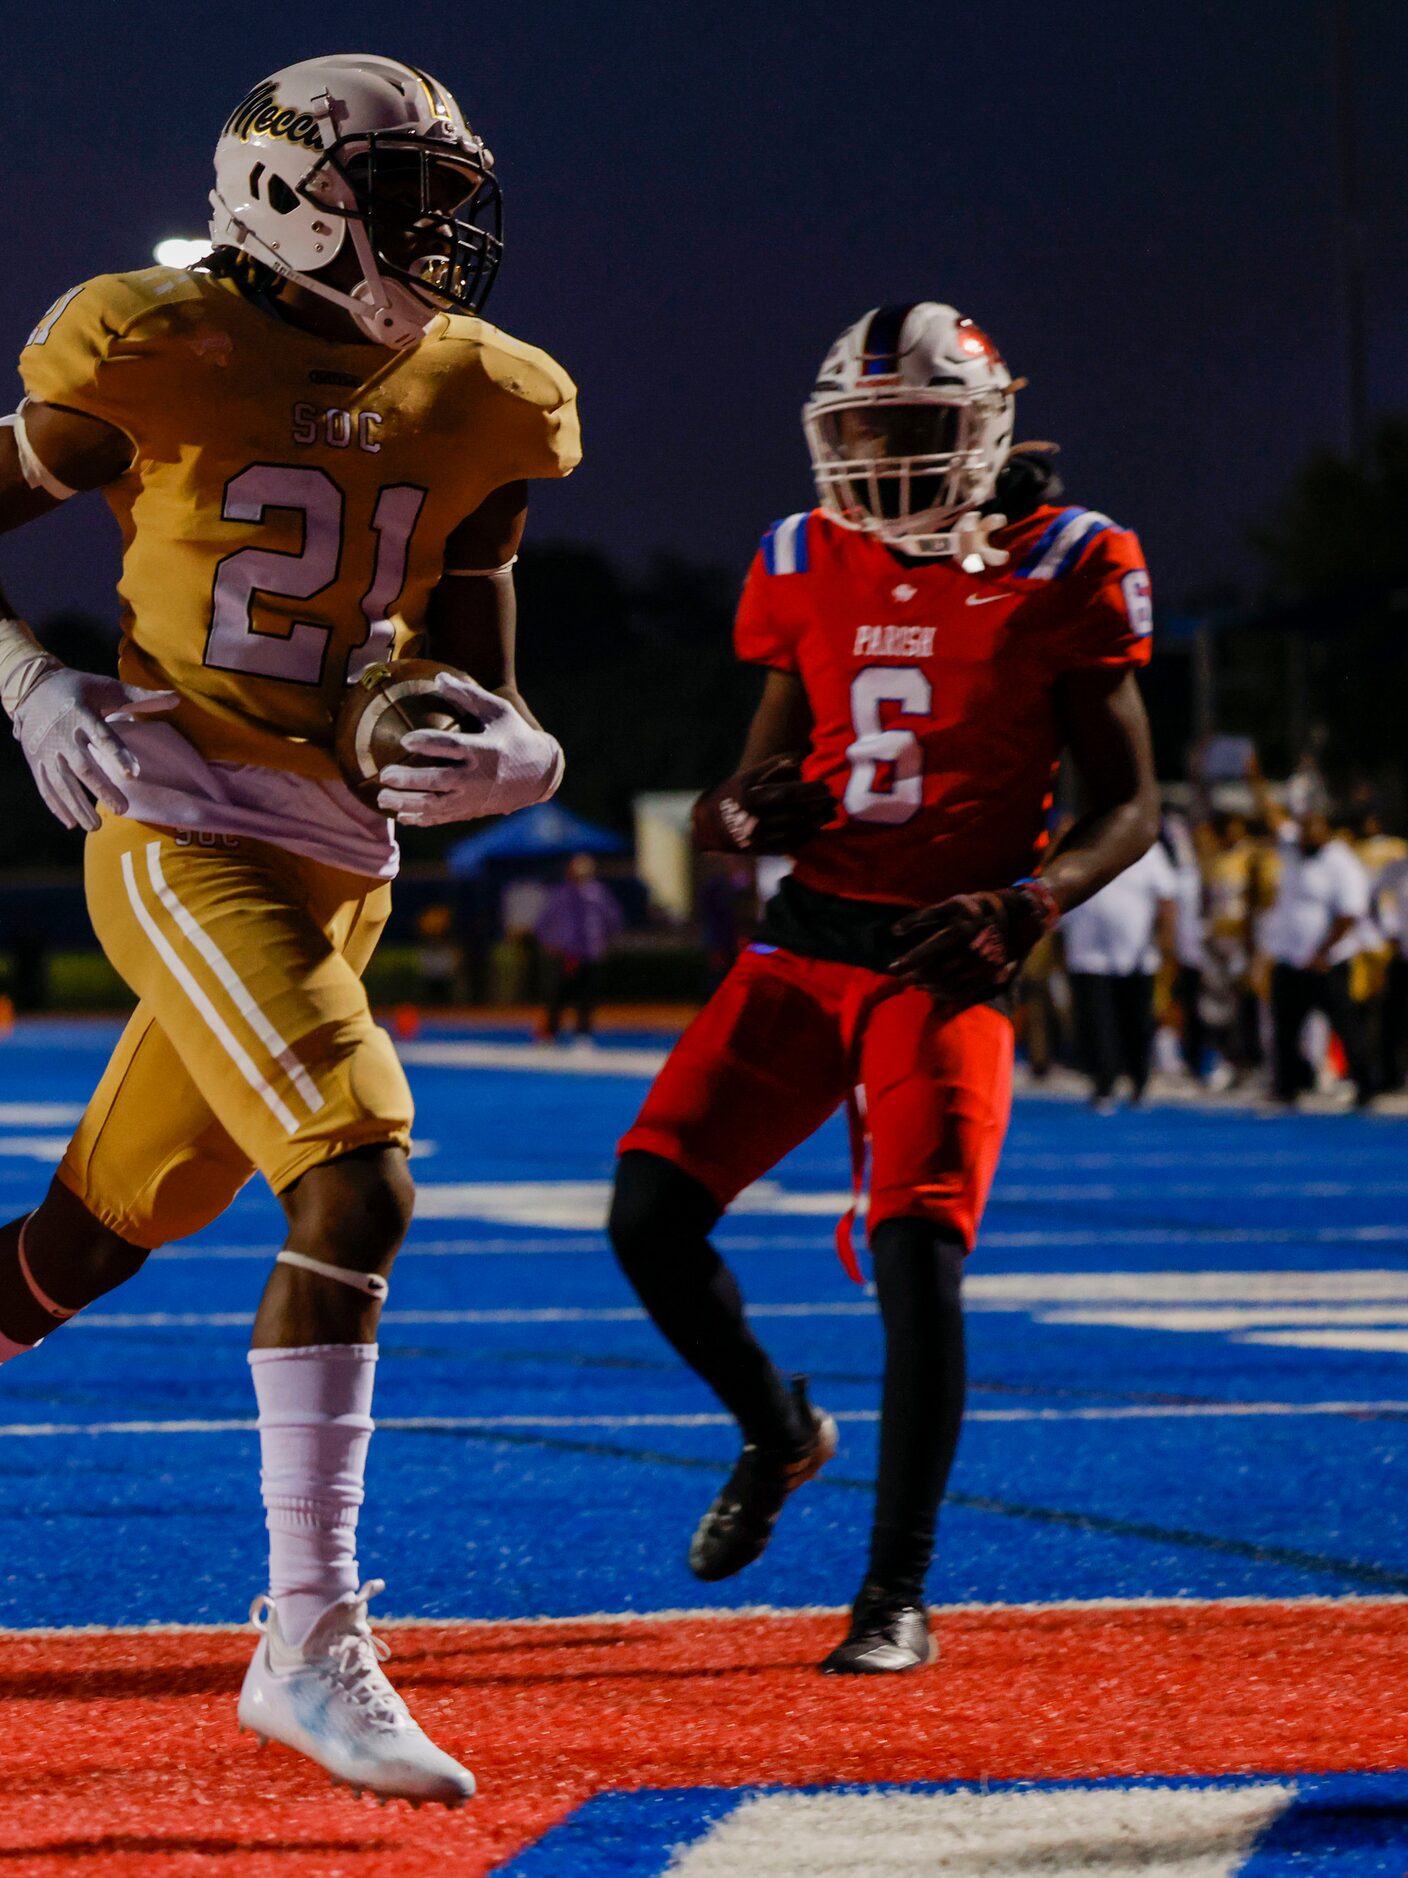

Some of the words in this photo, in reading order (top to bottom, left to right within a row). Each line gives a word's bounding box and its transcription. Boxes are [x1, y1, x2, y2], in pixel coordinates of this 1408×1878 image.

[292, 401, 384, 455] SOC
[203, 460, 429, 689] 21
[852, 623, 938, 658] PARISH
[842, 665, 933, 825] 6
